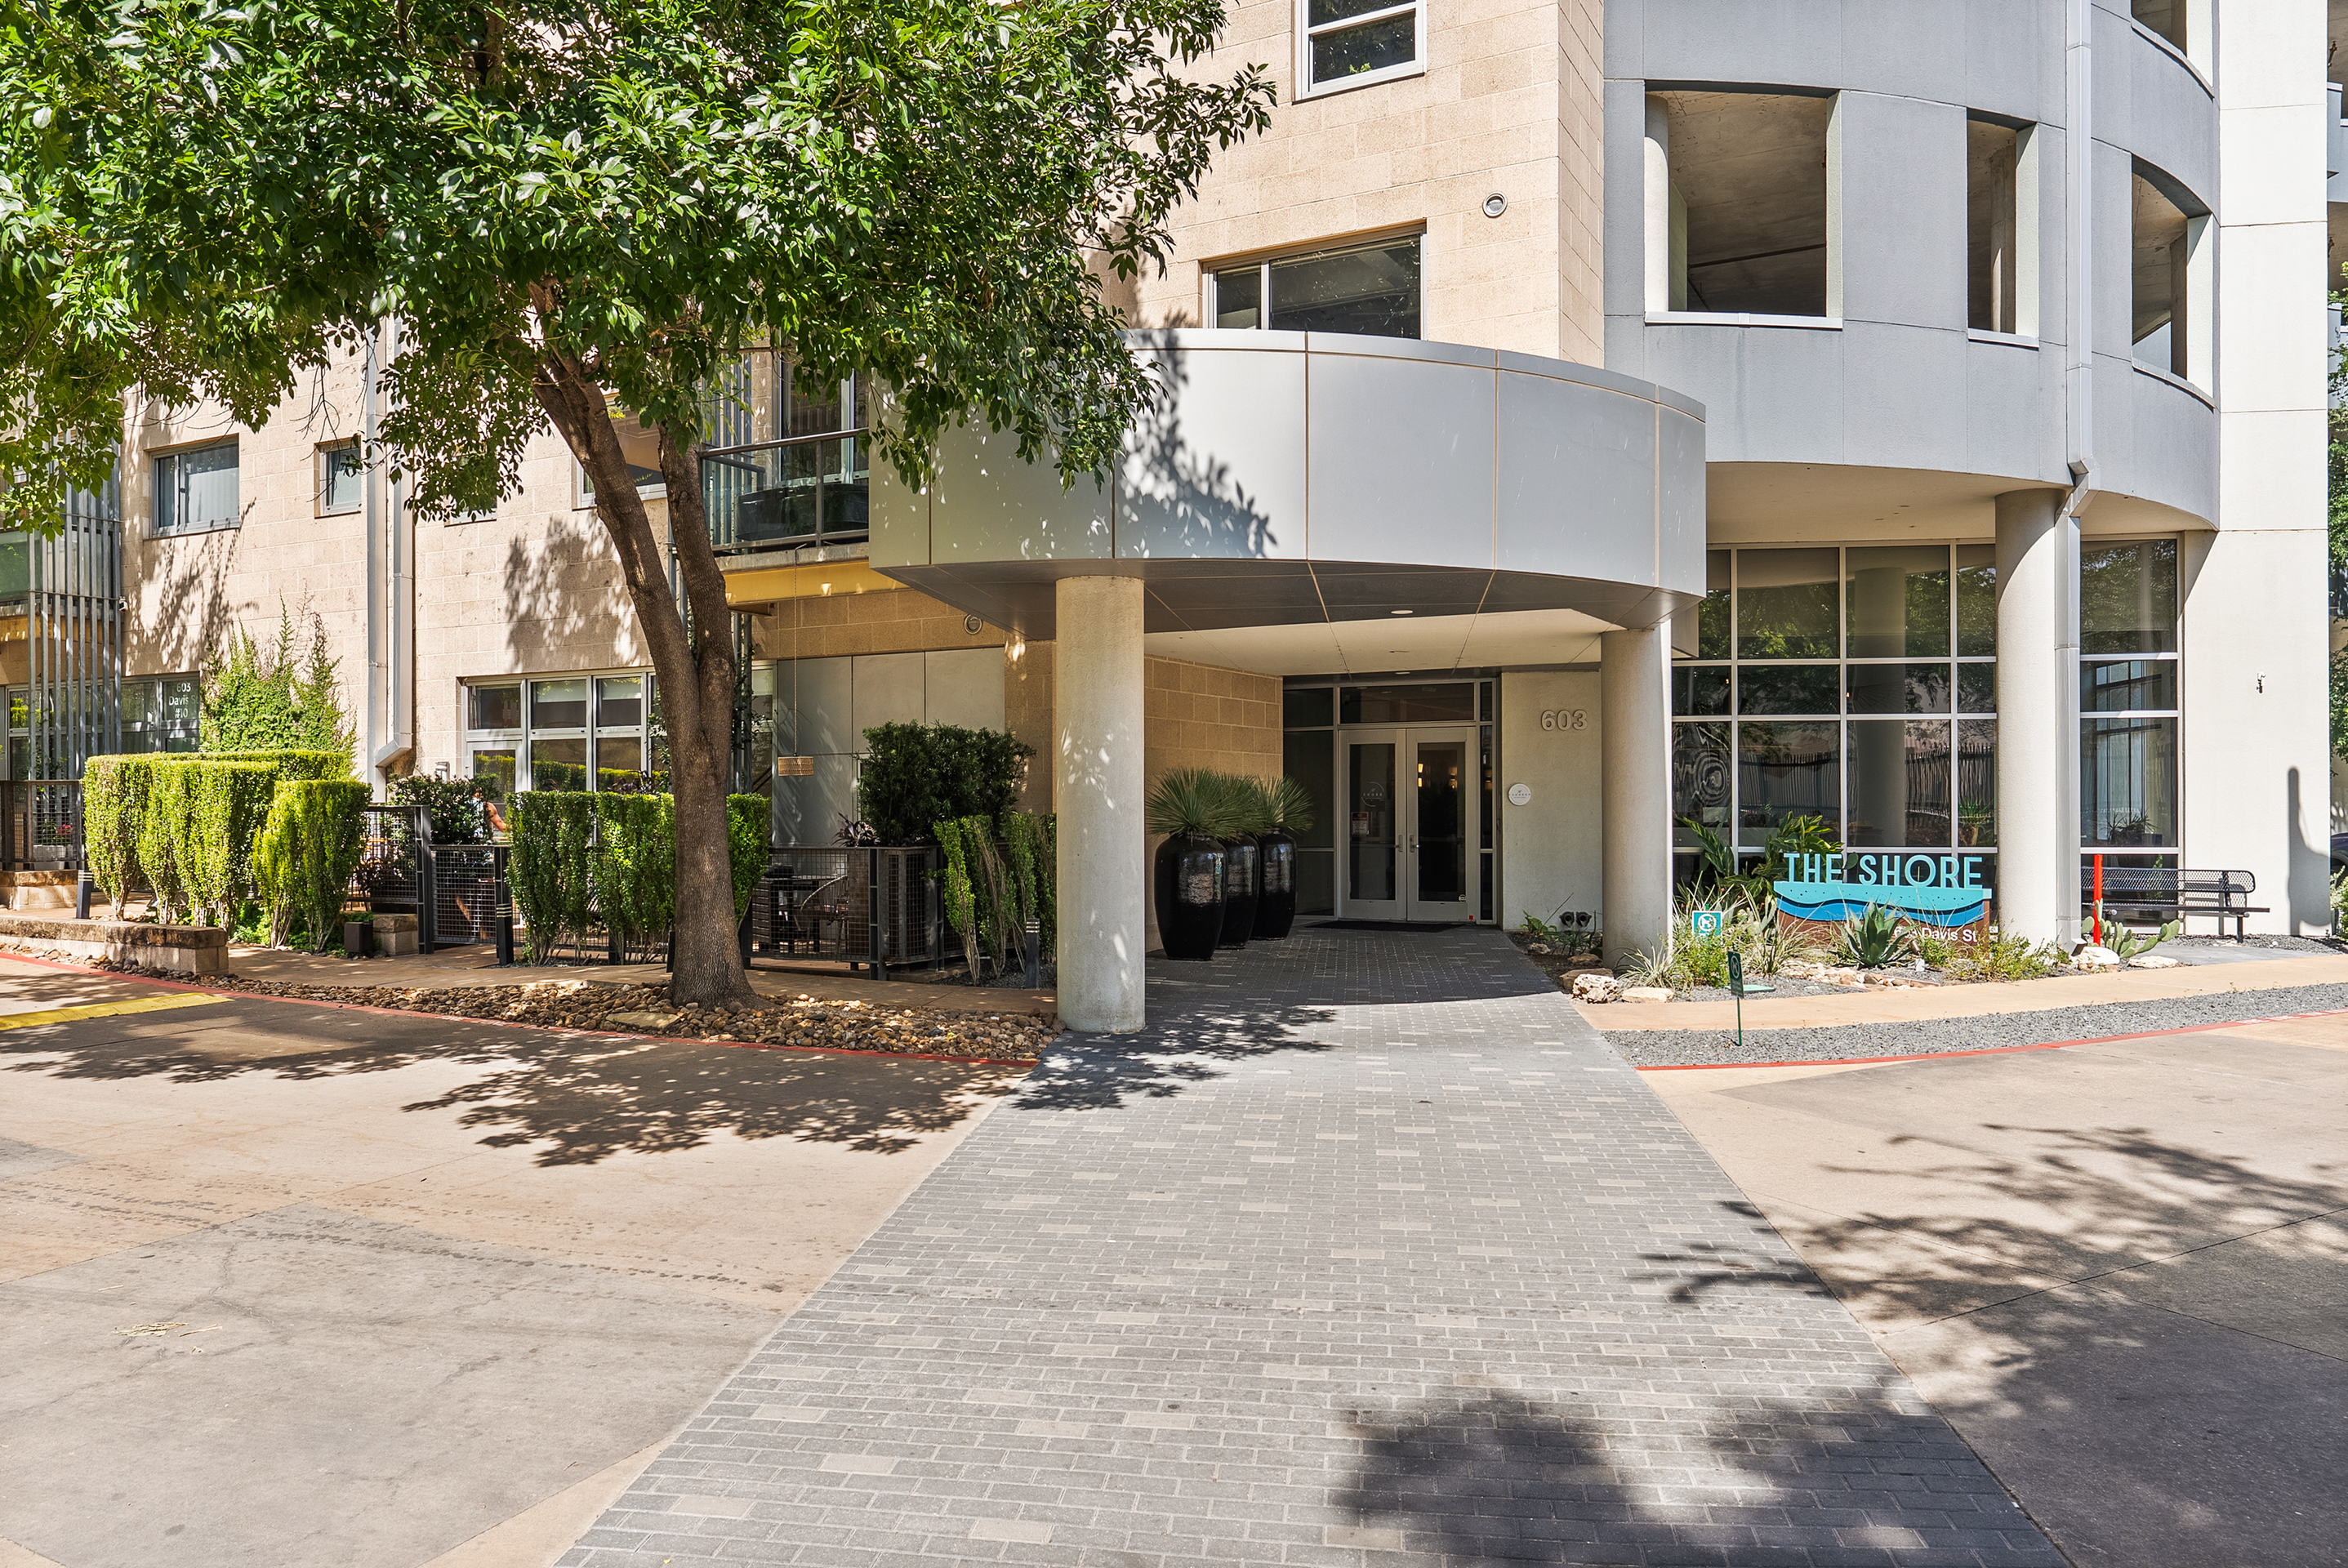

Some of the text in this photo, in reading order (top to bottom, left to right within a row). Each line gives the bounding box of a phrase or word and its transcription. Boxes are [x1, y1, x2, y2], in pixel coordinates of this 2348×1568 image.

[176, 682, 191, 693] 603
[168, 694, 189, 706] Davis
[174, 707, 189, 719] #10
[1541, 710, 1588, 731] 603
[1784, 853, 1983, 889] THE SHORE
[1894, 926, 1978, 942] 63 Davis St
